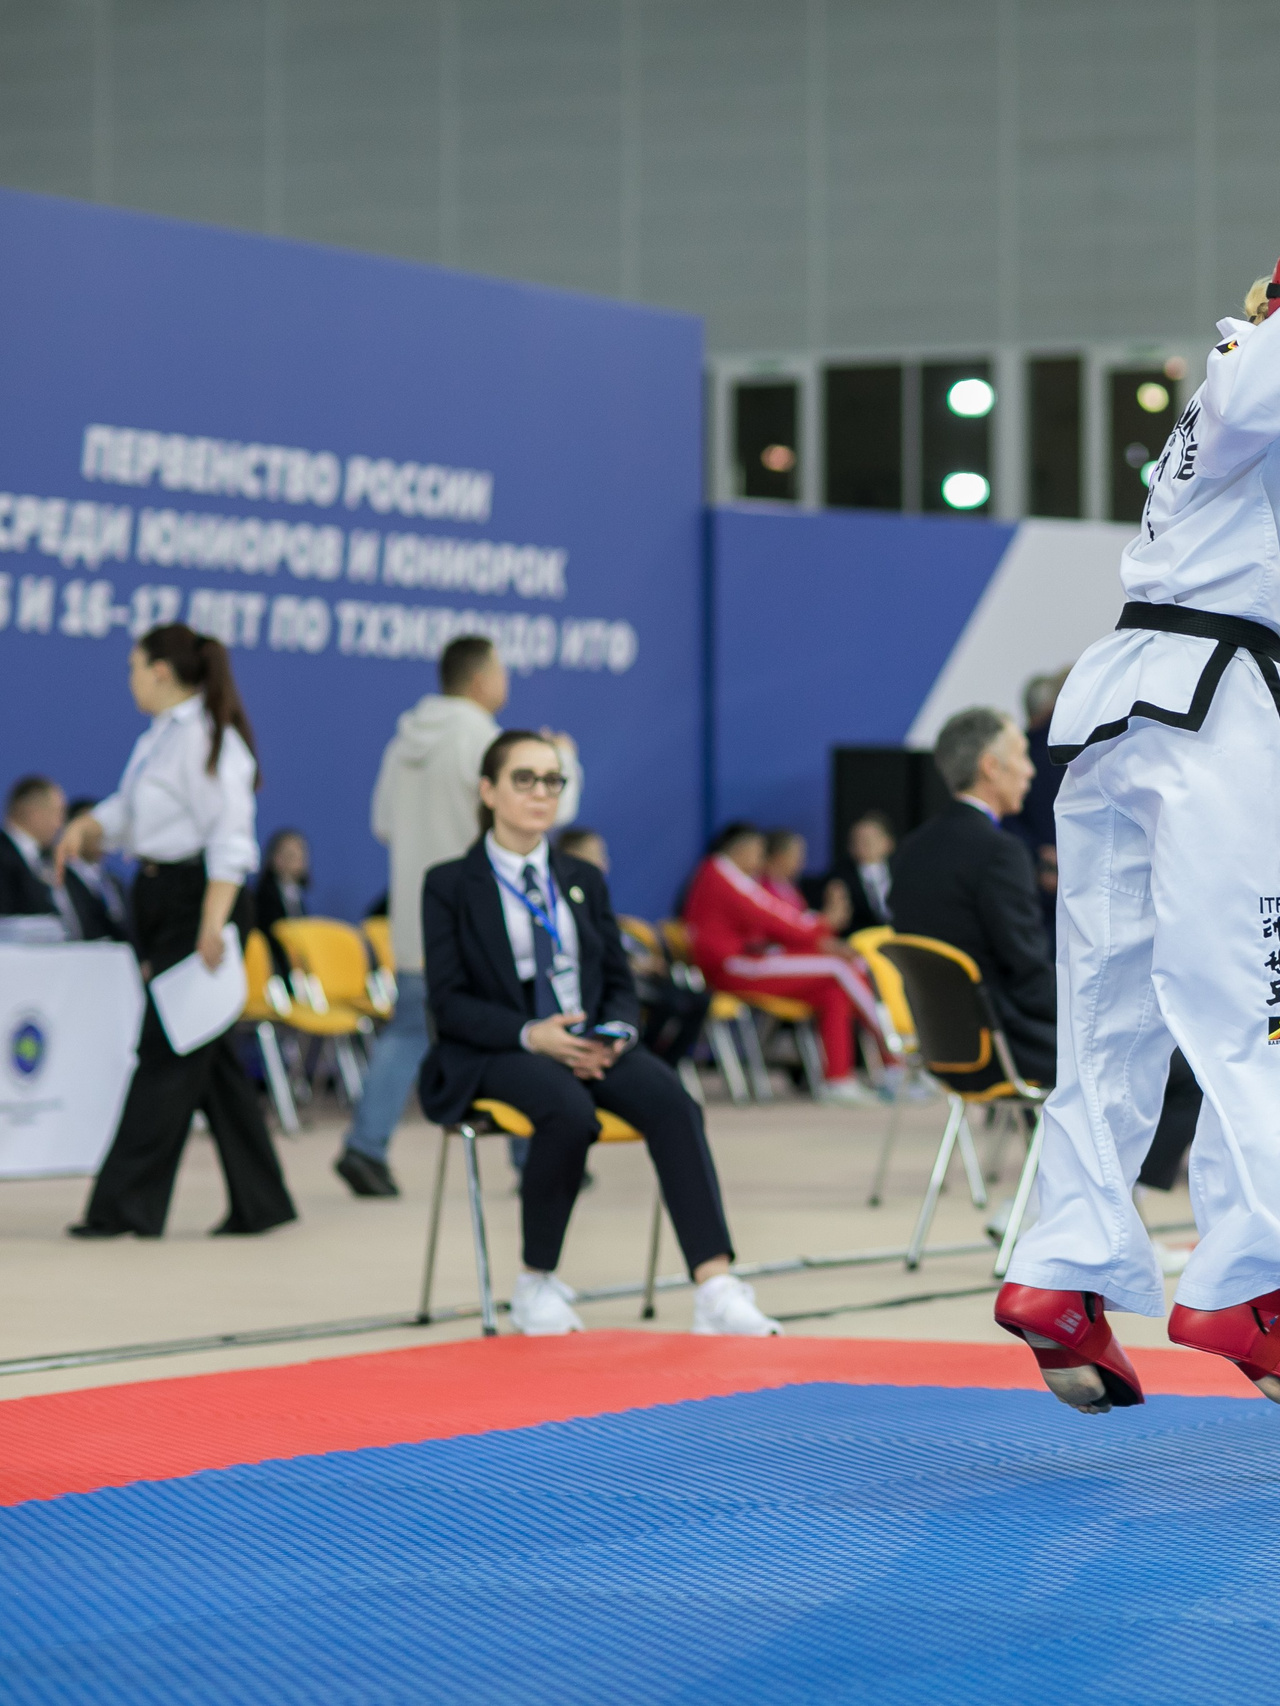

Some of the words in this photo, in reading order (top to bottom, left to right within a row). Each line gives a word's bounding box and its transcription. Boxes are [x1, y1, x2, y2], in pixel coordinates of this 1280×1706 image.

[82, 424, 339, 508] ПЕРВЕНСТВО
[344, 453, 494, 522] РОССИИ
[136, 506, 344, 583] ЮНИОРОВ
[348, 528, 381, 585] И
[384, 532, 569, 600] ЮНИОРОК
[17, 573, 56, 637] И
[187, 586, 266, 650] ЛЕТ
[267, 594, 332, 655] ПО
[558, 615, 639, 676] ИТФ
